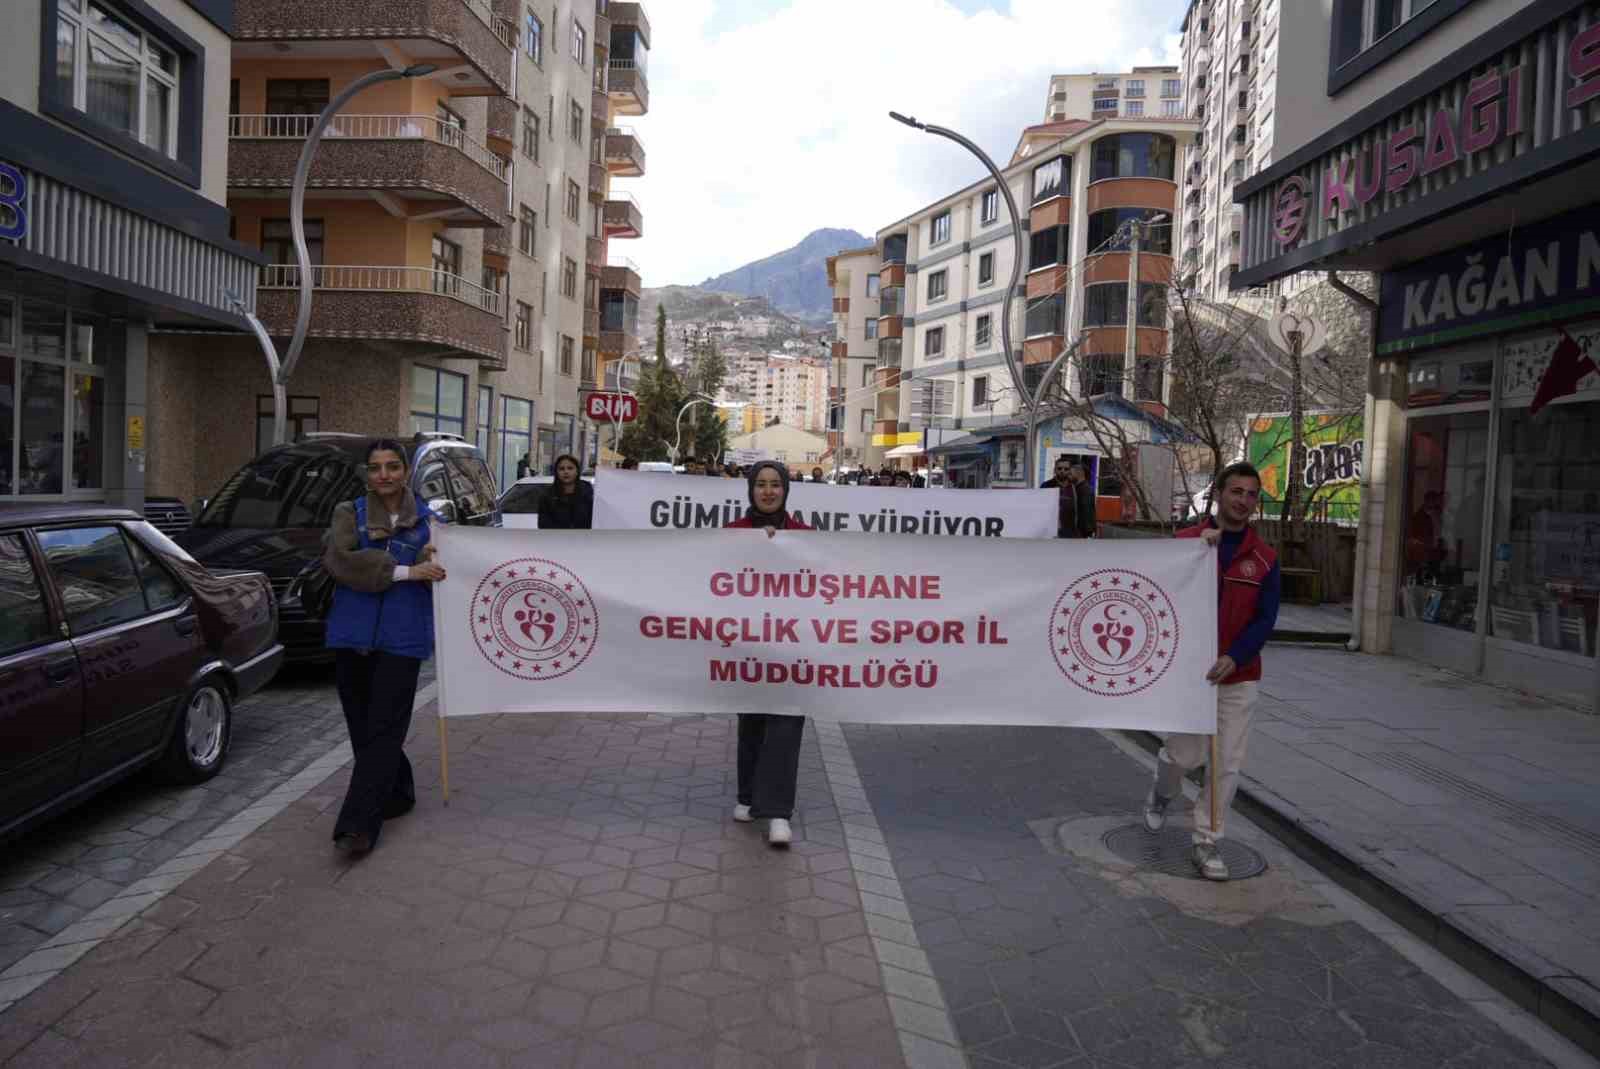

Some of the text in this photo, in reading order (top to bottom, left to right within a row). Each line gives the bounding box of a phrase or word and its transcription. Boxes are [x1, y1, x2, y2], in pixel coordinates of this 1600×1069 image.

[1403, 241, 1560, 331] KAĞAN
[591, 395, 632, 417] BİM
[651, 495, 849, 533] GÜMÜANE
[710, 568, 940, 605] GÜMÜŞHANE
[639, 613, 1009, 648] GENÇLİK VE SPOR İL
[709, 658, 938, 690] MÜDÜRLÜĞÜ
